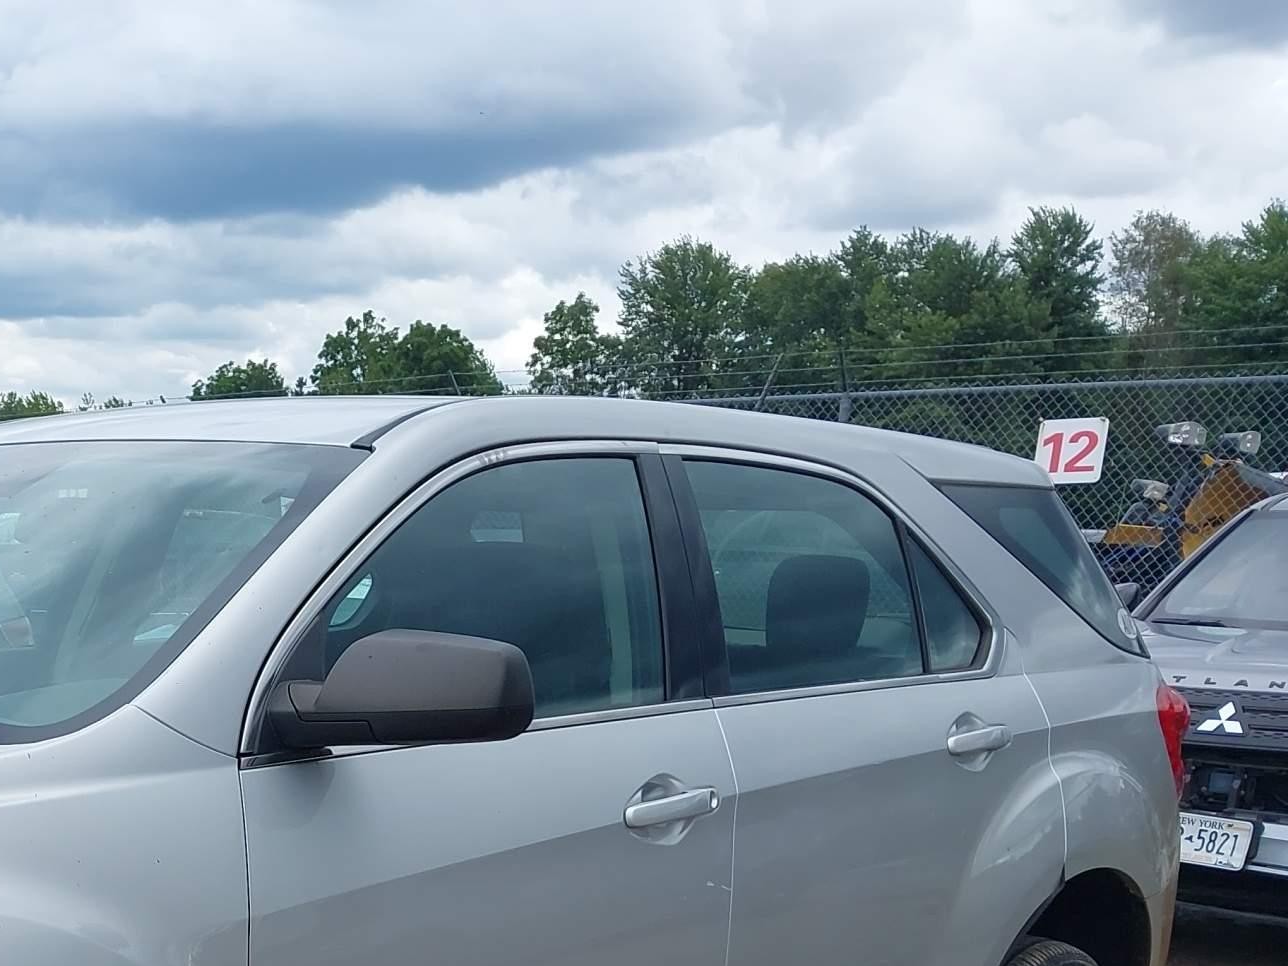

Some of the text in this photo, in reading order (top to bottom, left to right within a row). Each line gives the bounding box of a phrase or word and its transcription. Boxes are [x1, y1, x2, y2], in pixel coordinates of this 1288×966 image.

[1042, 430, 1099, 474] 12
[1179, 815, 1225, 830] EW YORK
